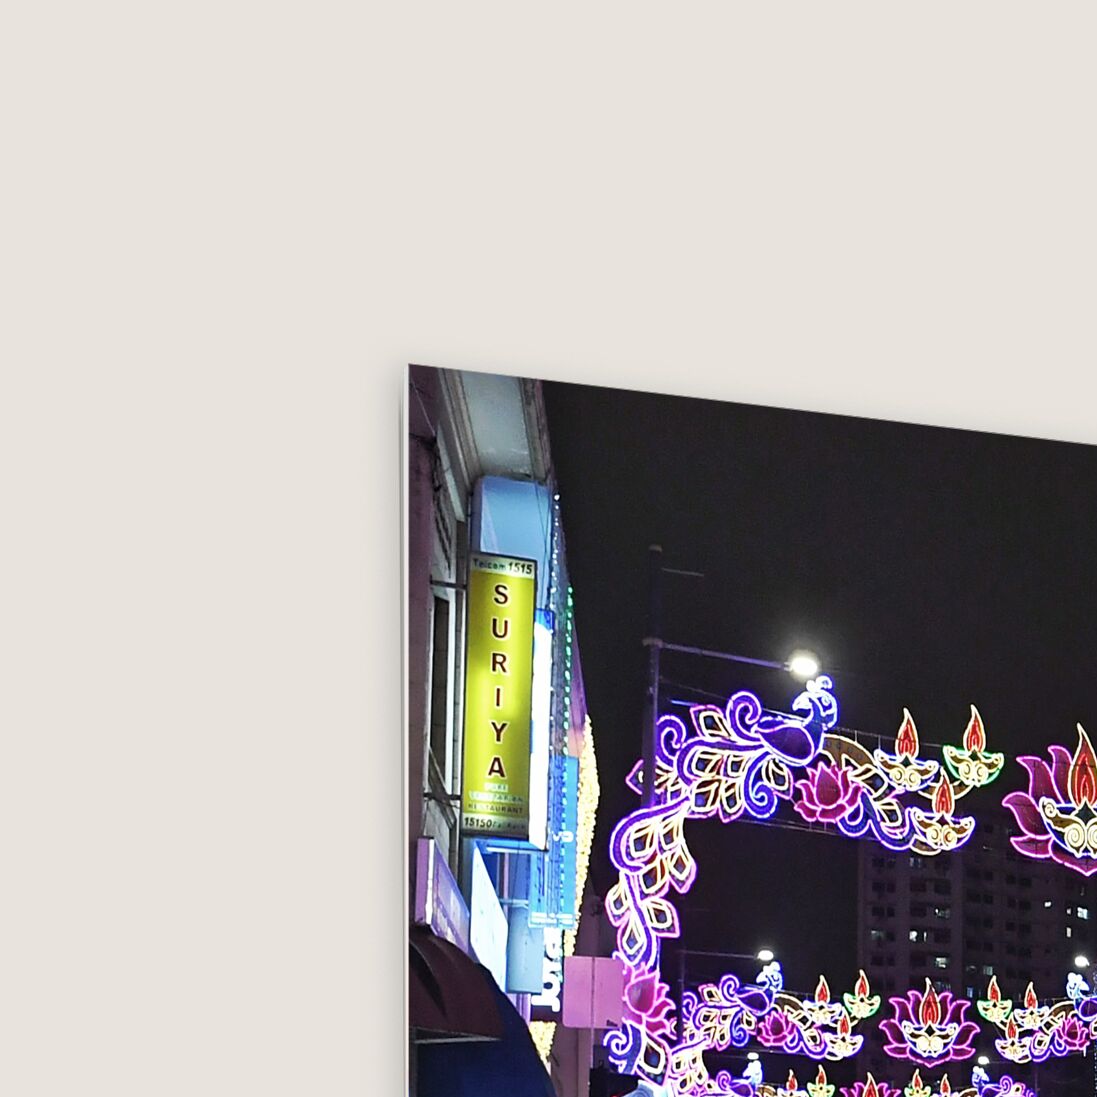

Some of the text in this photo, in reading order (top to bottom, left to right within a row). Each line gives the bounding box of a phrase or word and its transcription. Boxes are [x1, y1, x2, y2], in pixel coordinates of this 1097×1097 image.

[508, 561, 533, 575] 1515
[487, 583, 509, 778] SURIYA
[467, 803, 524, 814] RESTAURANT
